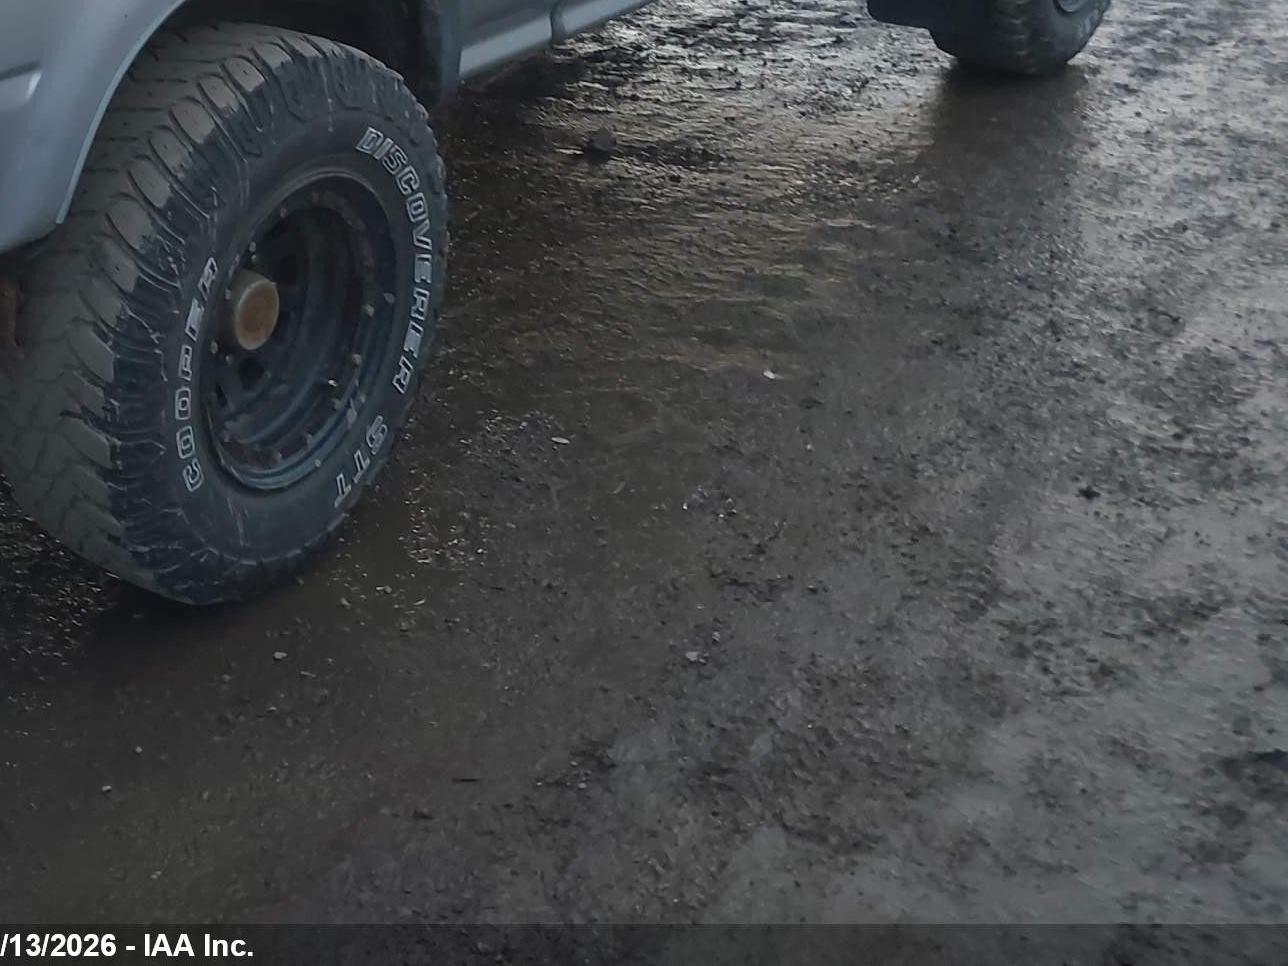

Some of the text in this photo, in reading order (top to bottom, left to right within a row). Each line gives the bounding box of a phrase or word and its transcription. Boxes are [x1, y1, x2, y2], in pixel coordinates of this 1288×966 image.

[174, 256, 219, 493] COOPER
[333, 126, 433, 508] DISCOVERER STT
